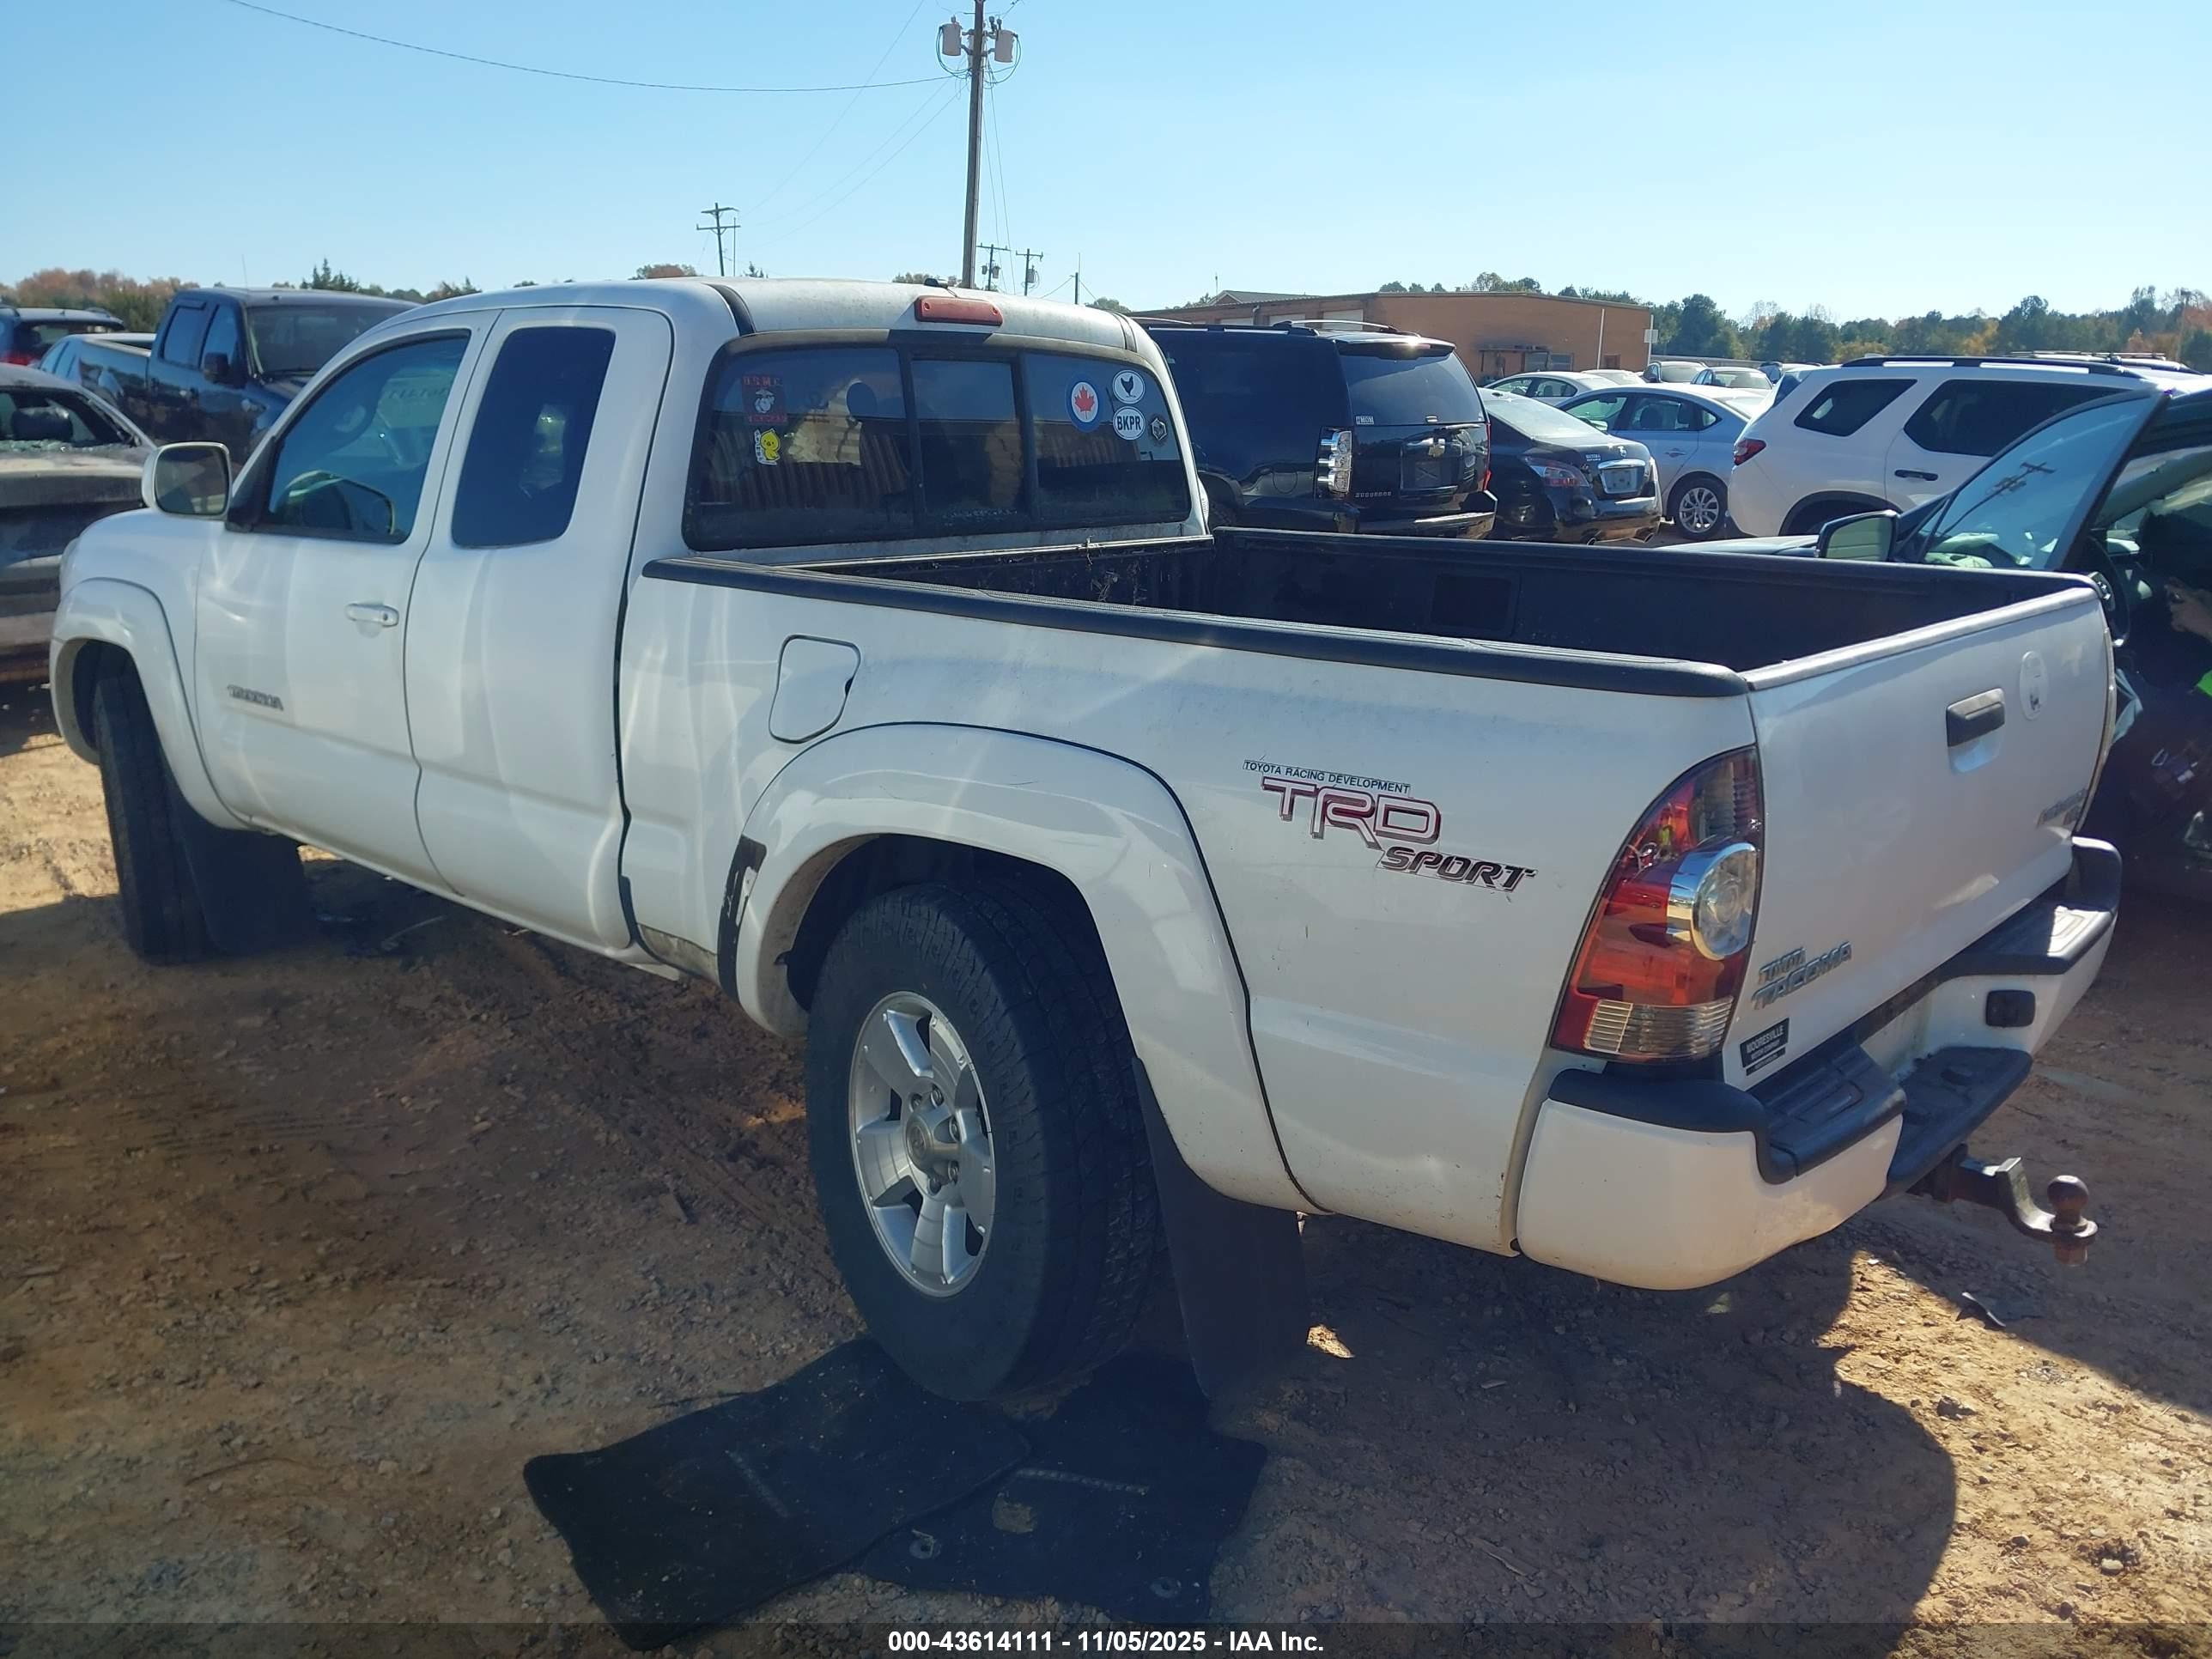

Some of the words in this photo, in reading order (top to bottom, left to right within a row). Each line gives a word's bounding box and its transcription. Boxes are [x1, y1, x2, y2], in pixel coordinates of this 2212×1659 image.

[1116, 415, 1142, 432] BKPR
[1244, 761, 1282, 775] TOYOTA
[1285, 767, 1326, 781] RACING
[1328, 774, 1411, 795] DEVELOPMENT
[1261, 775, 1443, 850] TRD
[1380, 845, 1539, 893] SPORT
[1752, 941, 1853, 1011] TACOMA
